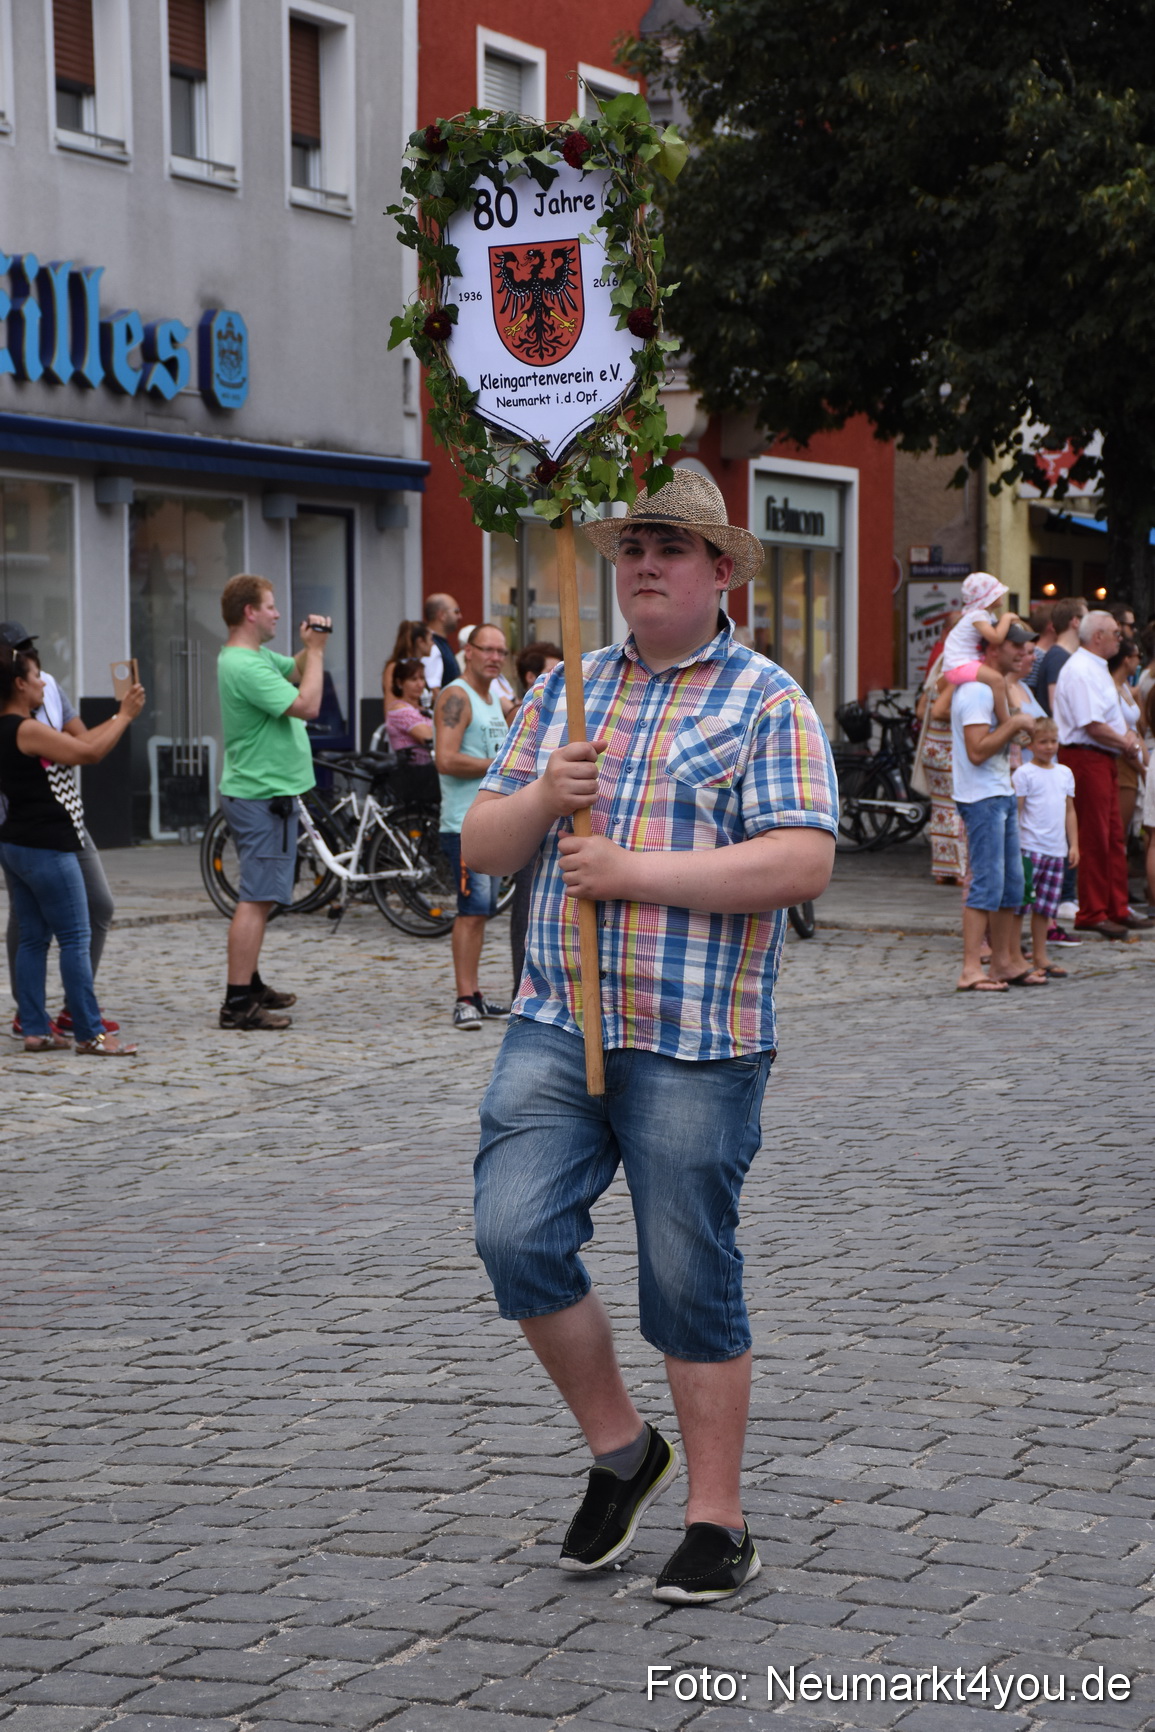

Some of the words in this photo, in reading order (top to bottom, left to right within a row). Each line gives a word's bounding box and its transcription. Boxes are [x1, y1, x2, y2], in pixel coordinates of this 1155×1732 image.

[473, 186, 518, 231] 80
[534, 189, 596, 217] Jahre
[593, 277, 619, 288] 2016
[459, 291, 483, 302] 1936
[480, 367, 594, 392] Kleingartenverein
[600, 363, 623, 382] e.V.
[496, 393, 551, 409] Neumarkt
